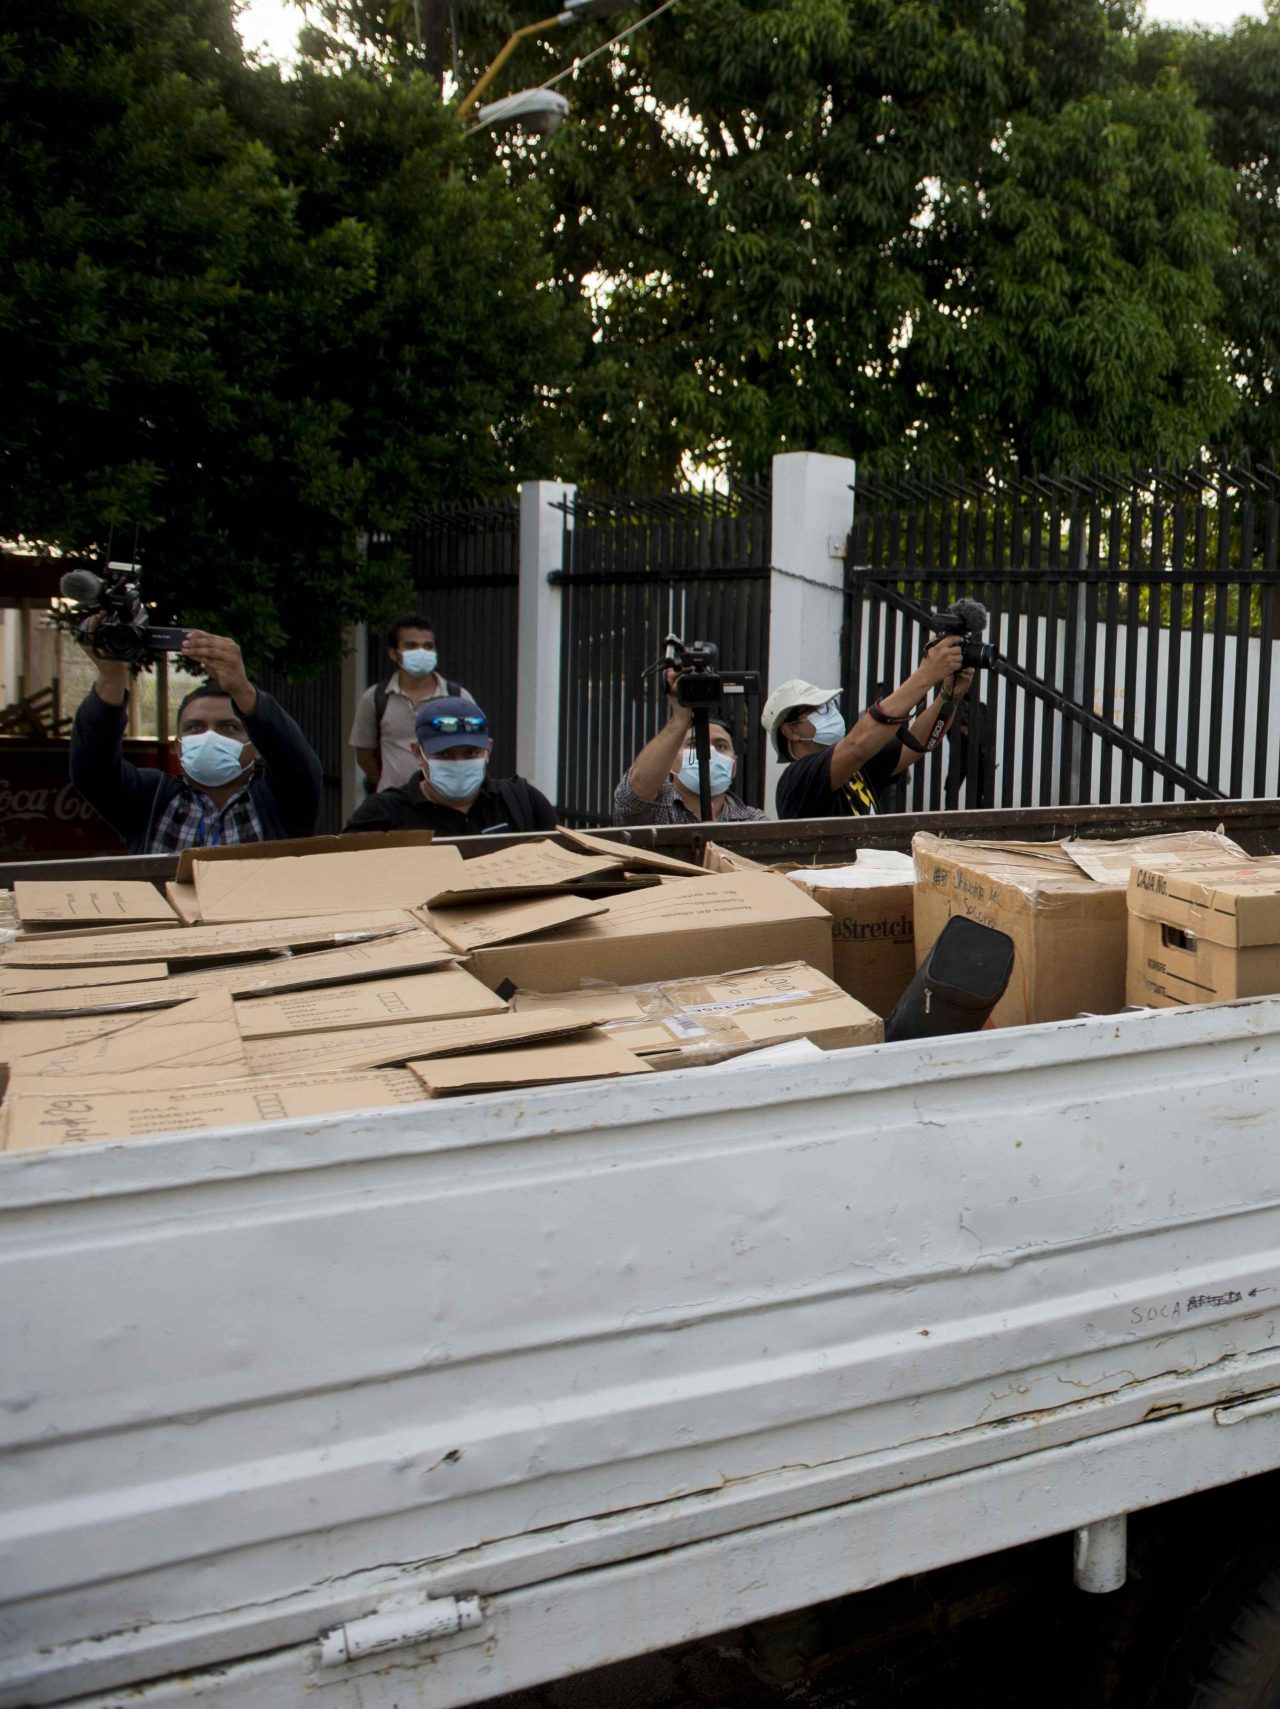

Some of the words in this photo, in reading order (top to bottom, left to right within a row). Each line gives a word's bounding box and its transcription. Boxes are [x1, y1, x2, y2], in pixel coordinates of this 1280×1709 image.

[931, 719, 945, 737] EOS
[1136, 869, 1155, 892] CAJA
[128, 1105, 178, 1115] SALA
[128, 1107, 225, 1122] COMEDOR
[129, 1117, 204, 1128] COCINA
[1130, 1301, 1181, 1325] SOCA
